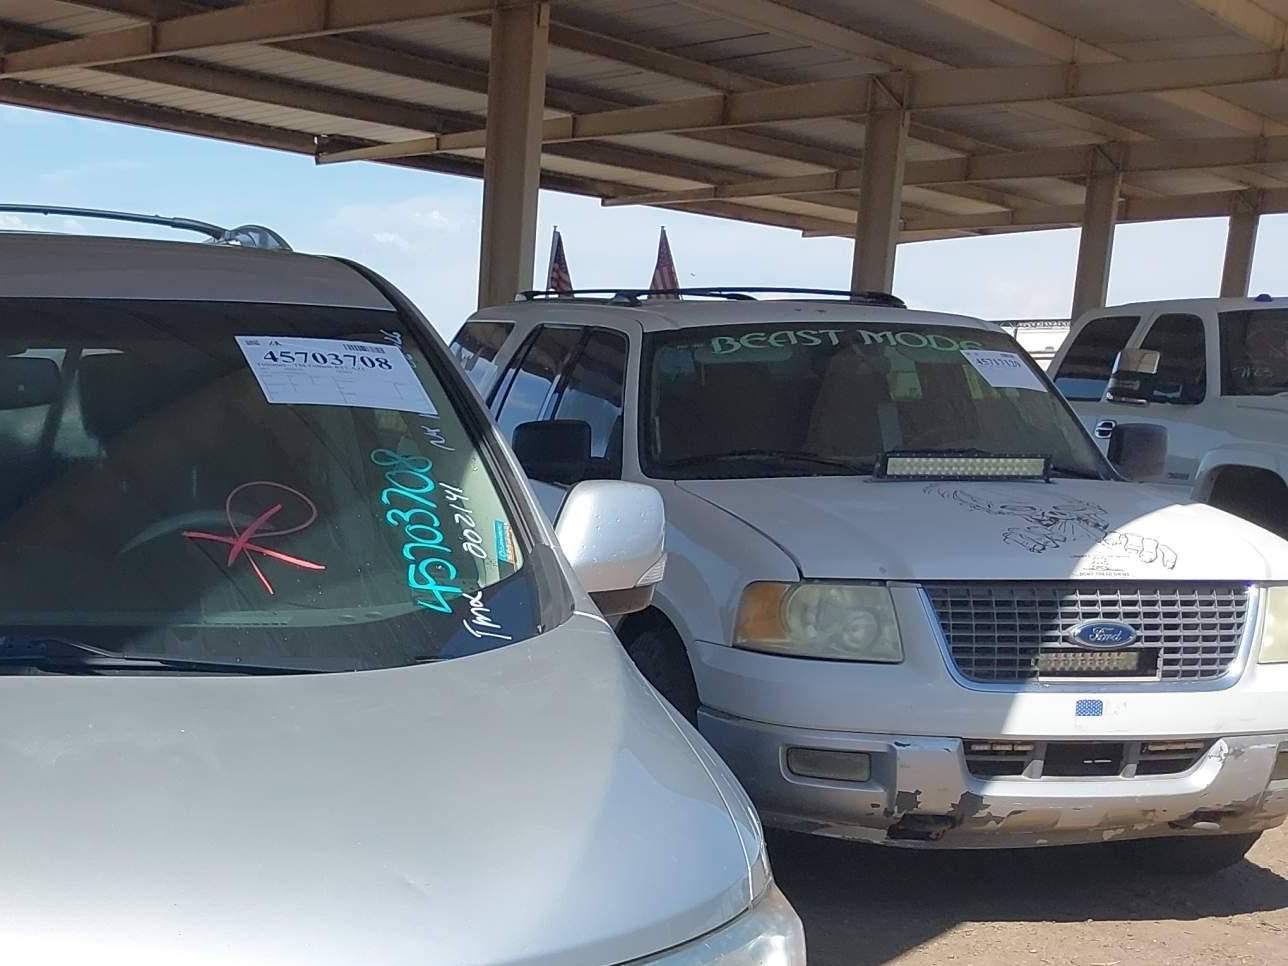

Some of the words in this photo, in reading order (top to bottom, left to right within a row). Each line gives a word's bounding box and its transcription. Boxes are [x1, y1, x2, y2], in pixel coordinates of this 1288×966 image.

[711, 329, 844, 354] BEAST
[263, 350, 393, 371] 45703708
[371, 449, 462, 614] 45703708
[1089, 626, 1123, 641] Ford
